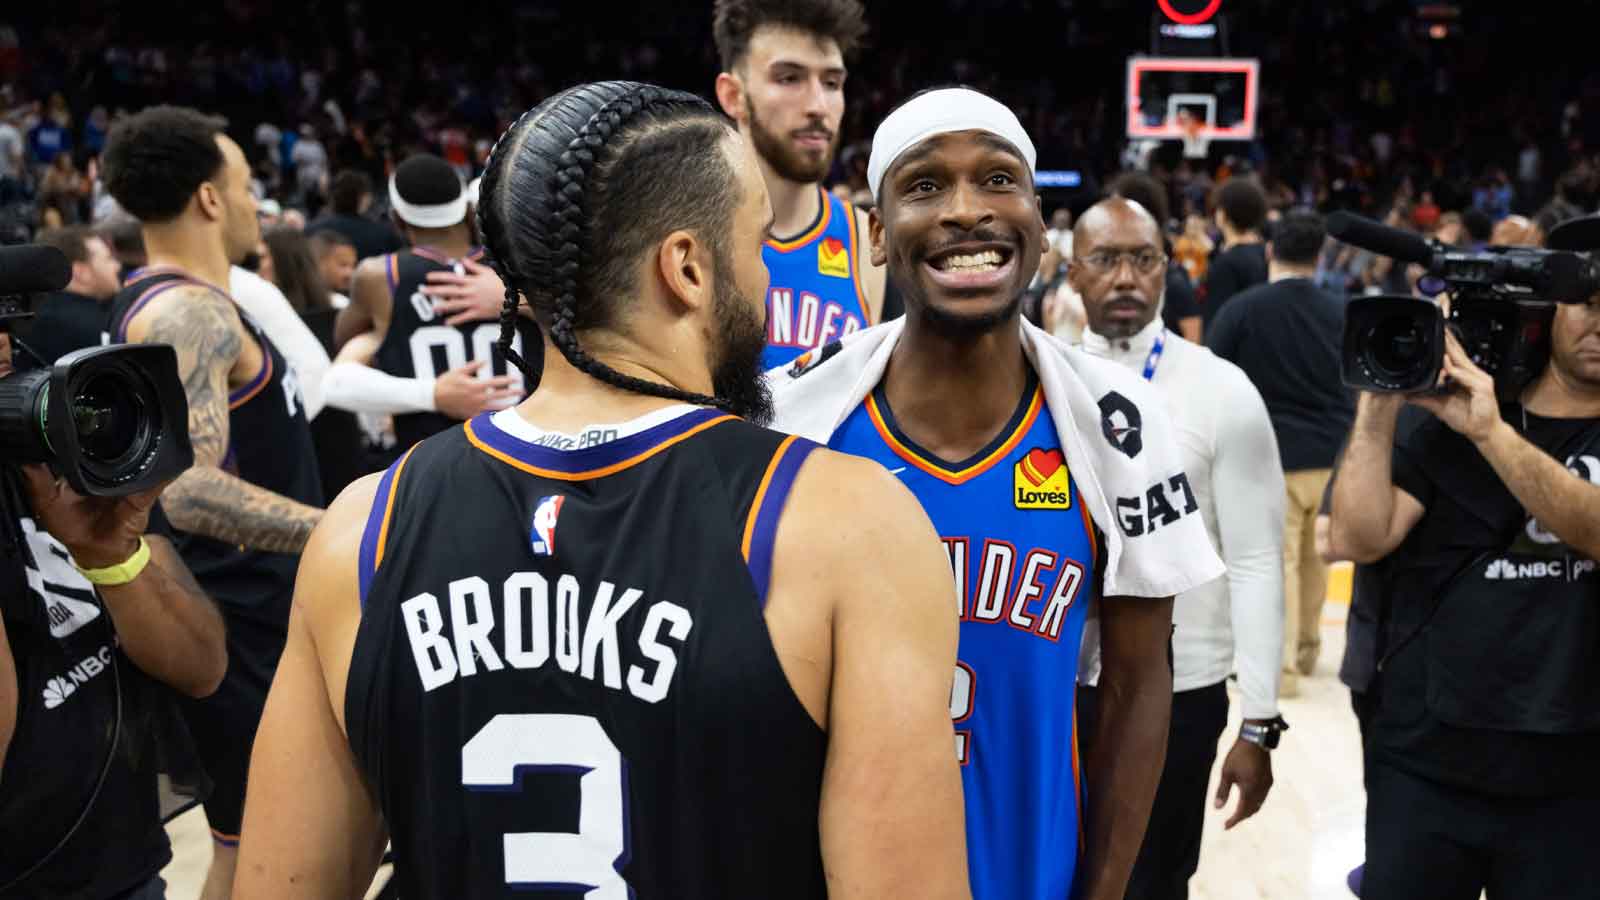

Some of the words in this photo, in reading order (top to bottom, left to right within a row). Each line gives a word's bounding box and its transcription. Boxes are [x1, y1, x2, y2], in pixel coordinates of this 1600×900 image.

[578, 429, 619, 449] PRO
[1116, 472, 1199, 537] GAT
[1518, 561, 1562, 578] NBC
[400, 571, 694, 704] BROOKS
[68, 646, 112, 687] NBC
[461, 713, 636, 900] 3
